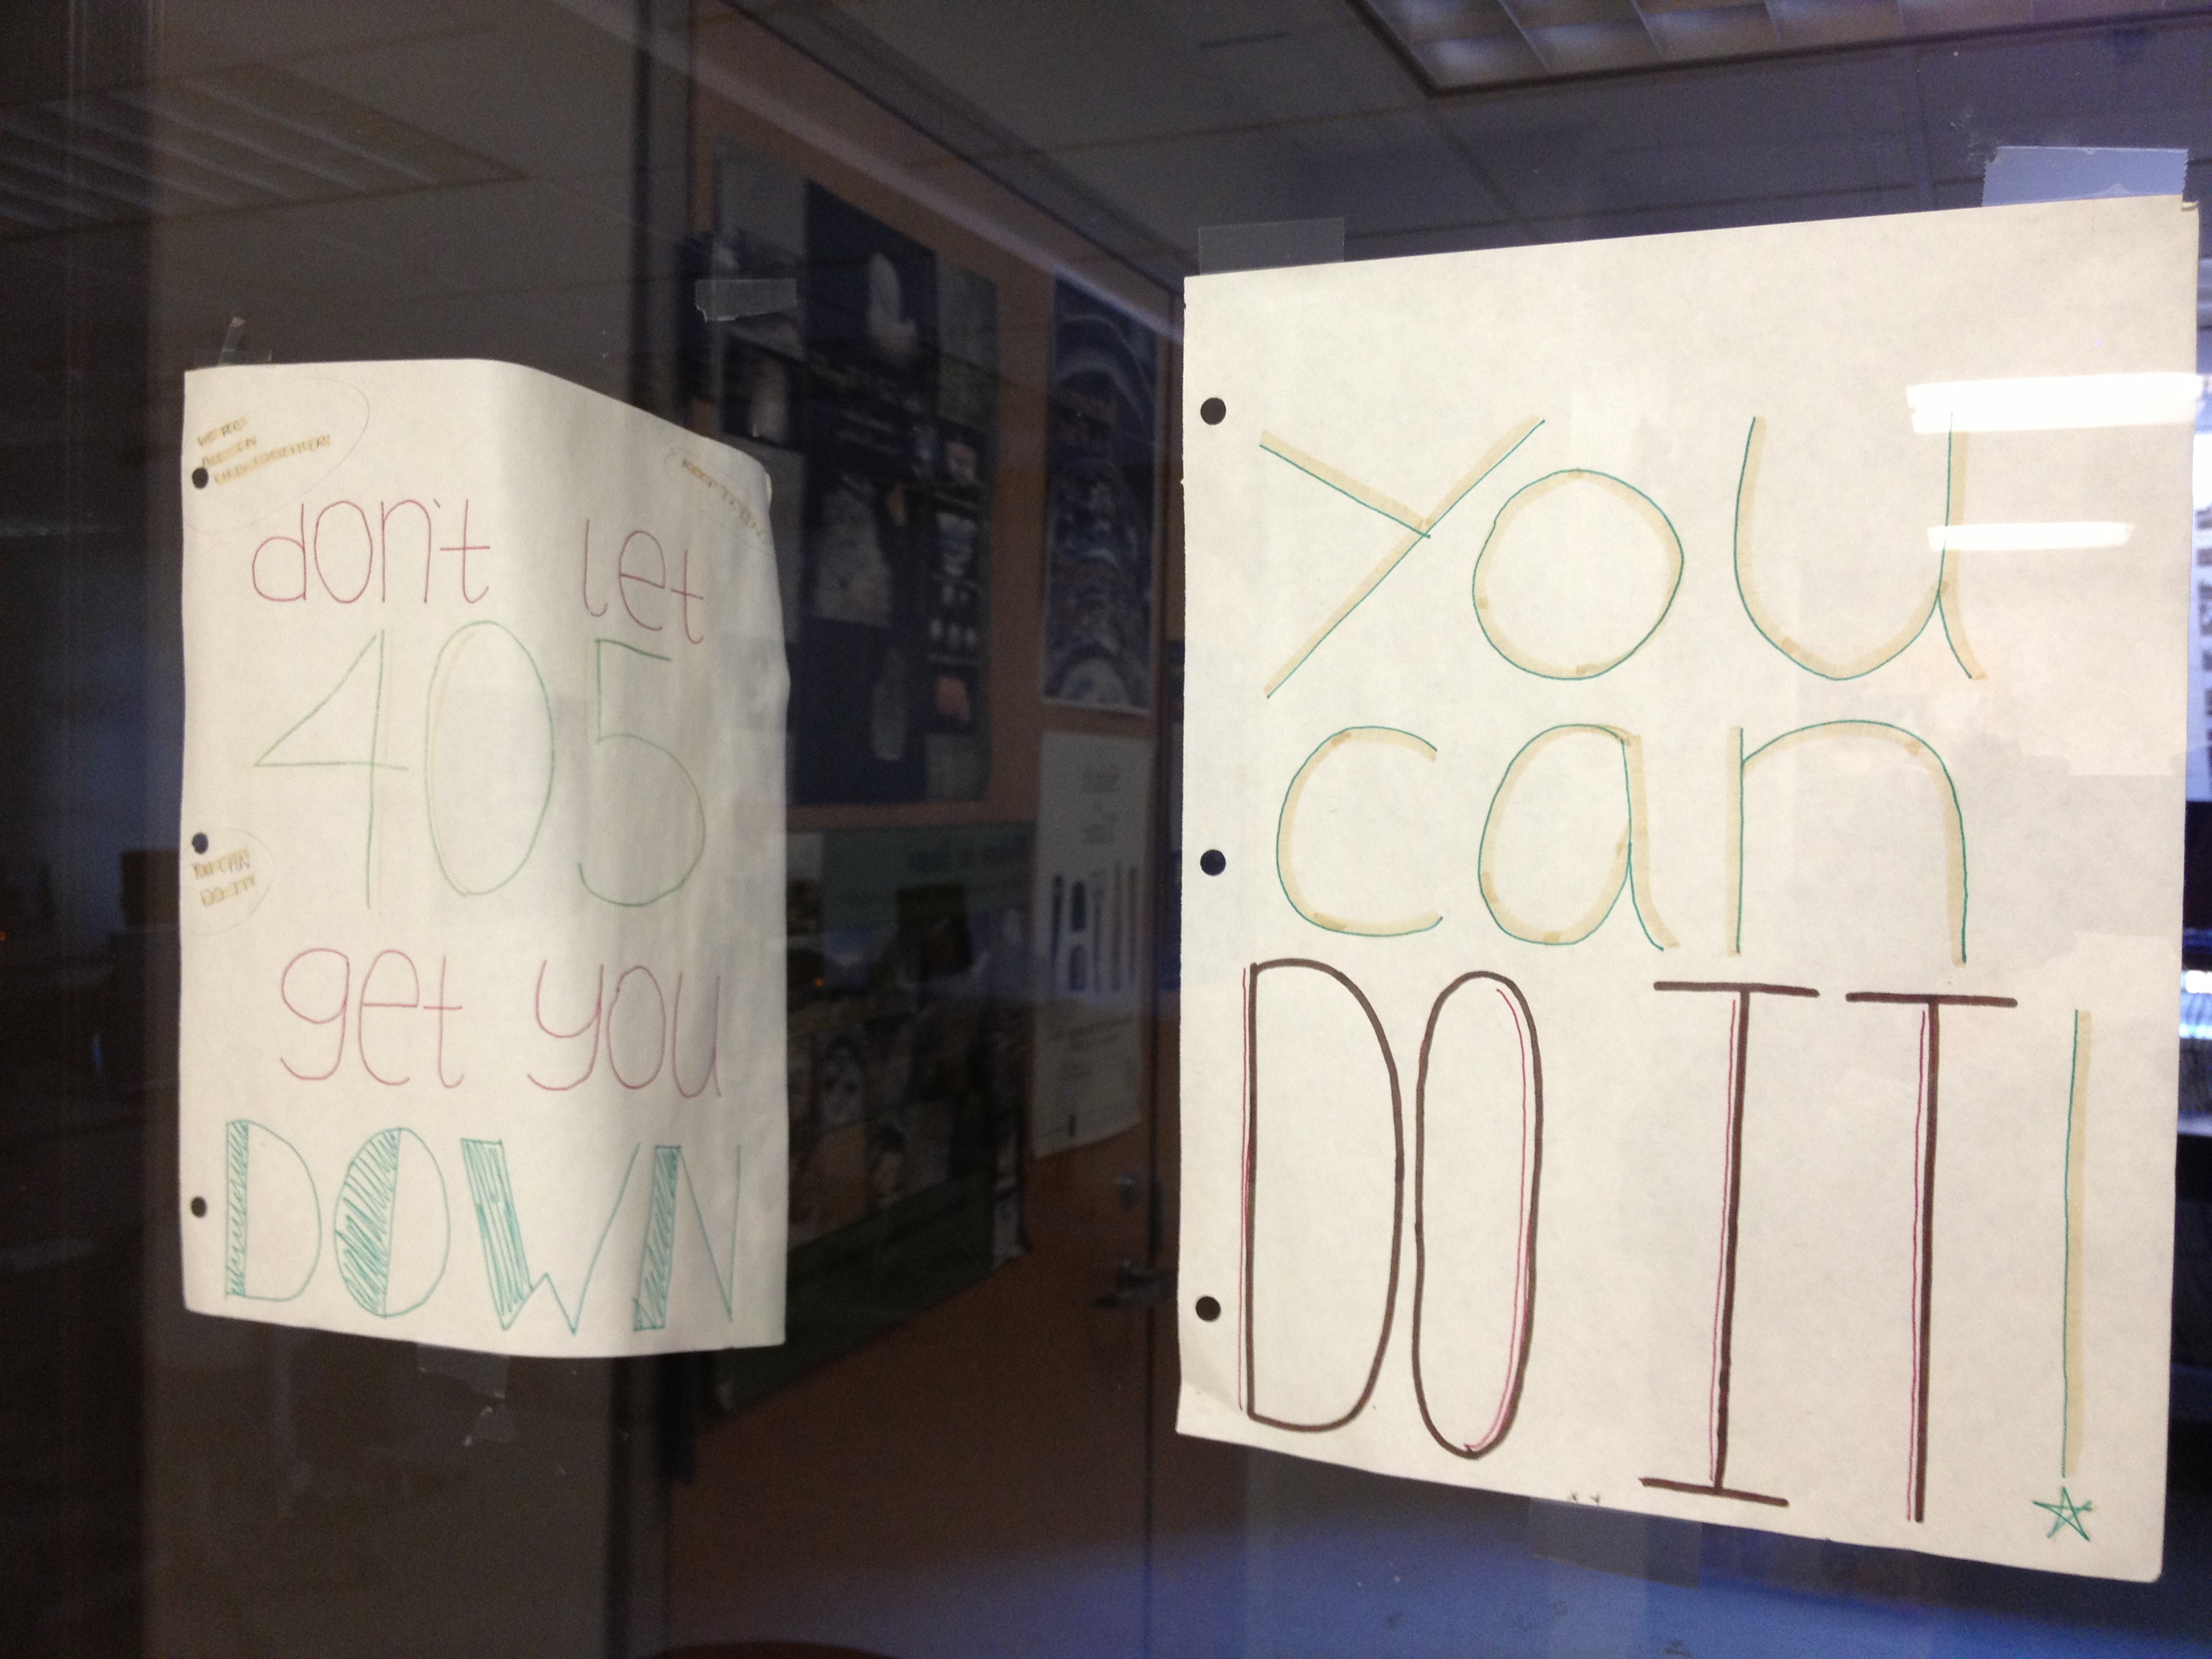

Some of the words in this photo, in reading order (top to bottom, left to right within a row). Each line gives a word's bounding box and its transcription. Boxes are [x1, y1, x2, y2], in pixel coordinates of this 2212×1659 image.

[252, 498, 491, 604] don't
[582, 518, 705, 644] let
[253, 619, 707, 910] 405
[1275, 717, 1969, 968] can
[200, 885, 225, 907] DO
[218, 848, 251, 874] CAN
[279, 947, 466, 1089] get
[527, 959, 722, 1099] you
[224, 1118, 742, 1336] DOWN
[1238, 957, 1544, 1461] DO
